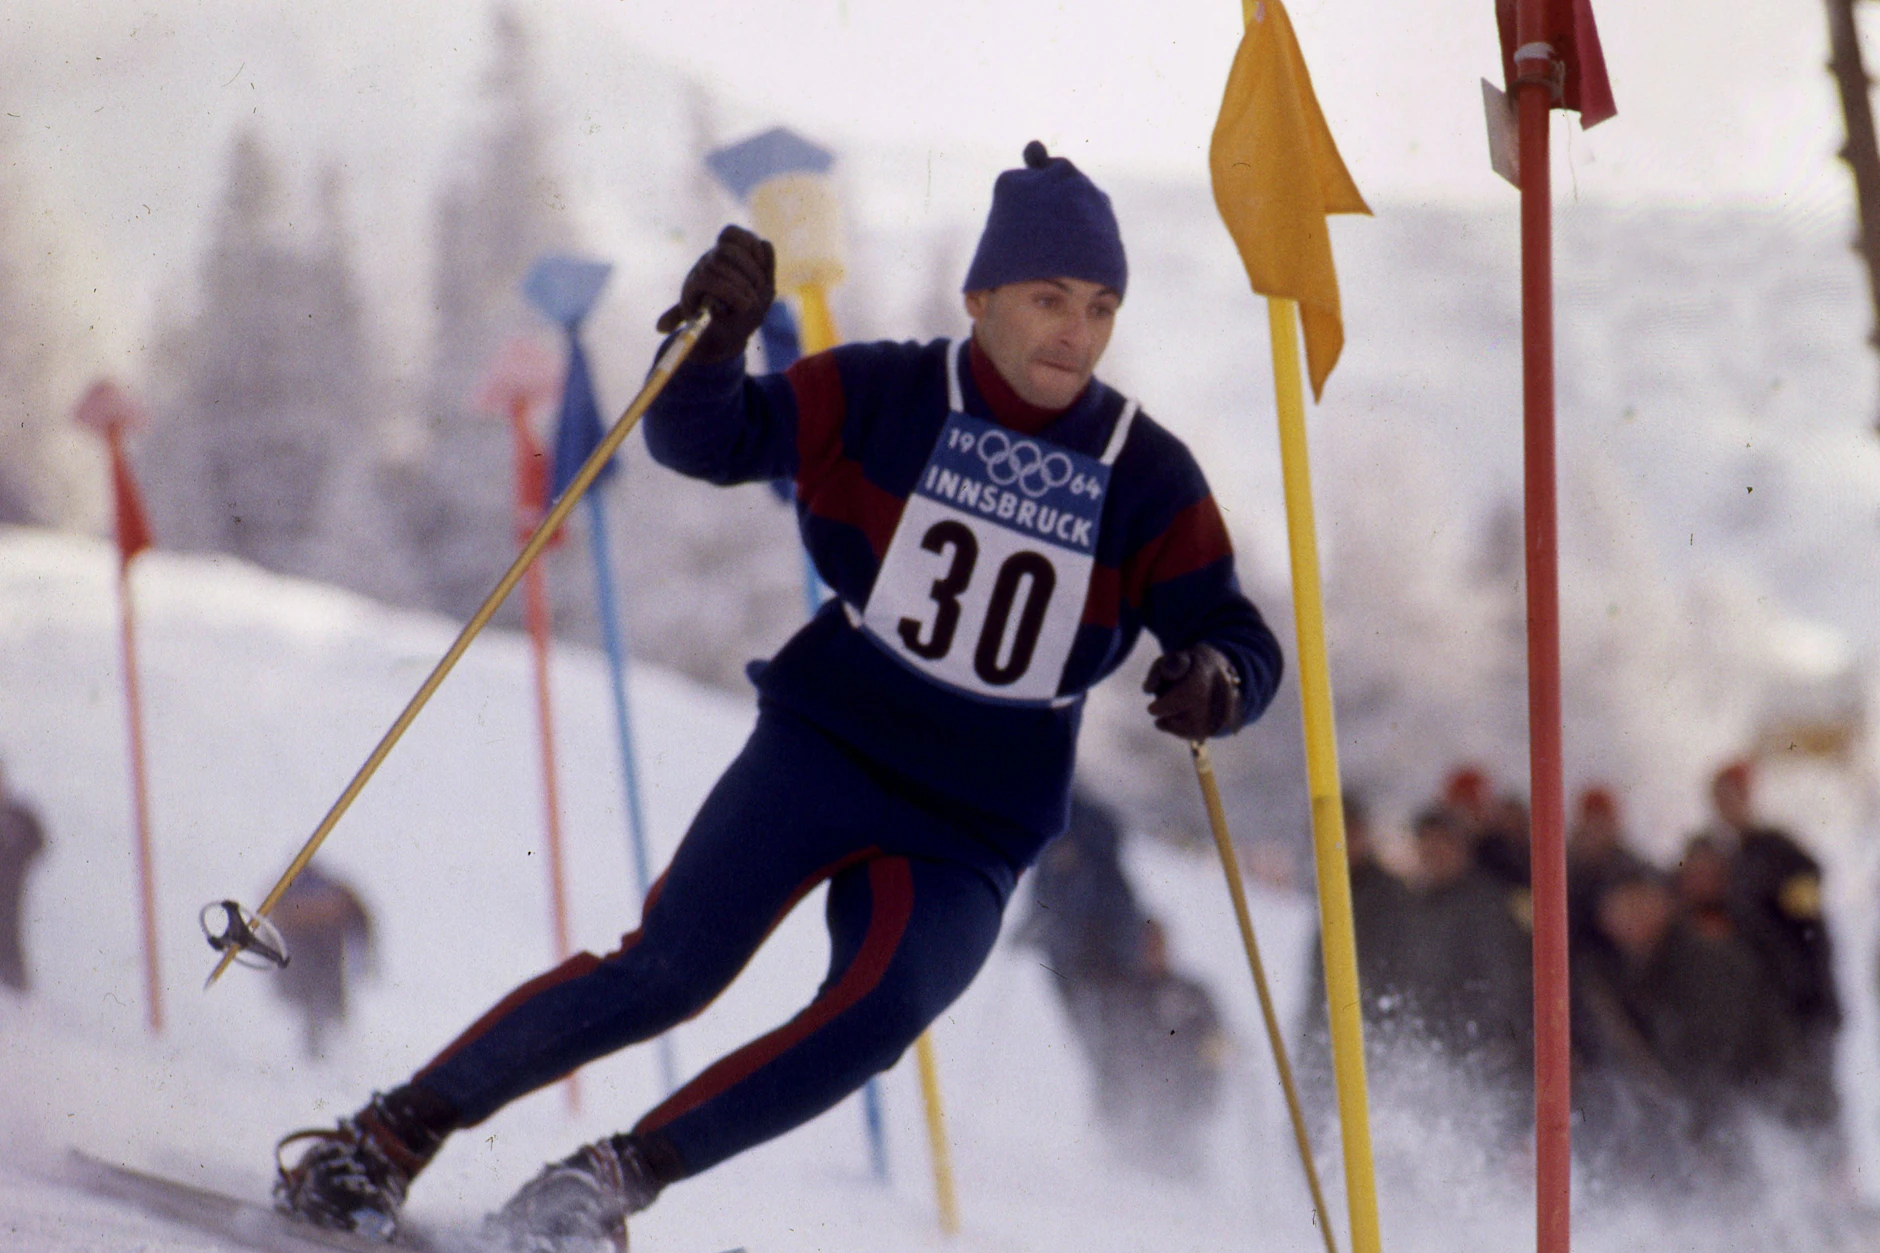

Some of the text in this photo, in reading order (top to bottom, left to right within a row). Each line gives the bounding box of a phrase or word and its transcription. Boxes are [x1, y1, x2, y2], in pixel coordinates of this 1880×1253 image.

[949, 428, 1101, 499] 19 64
[925, 465, 1092, 546] INNSBRUCK
[898, 519, 1056, 686] 30
